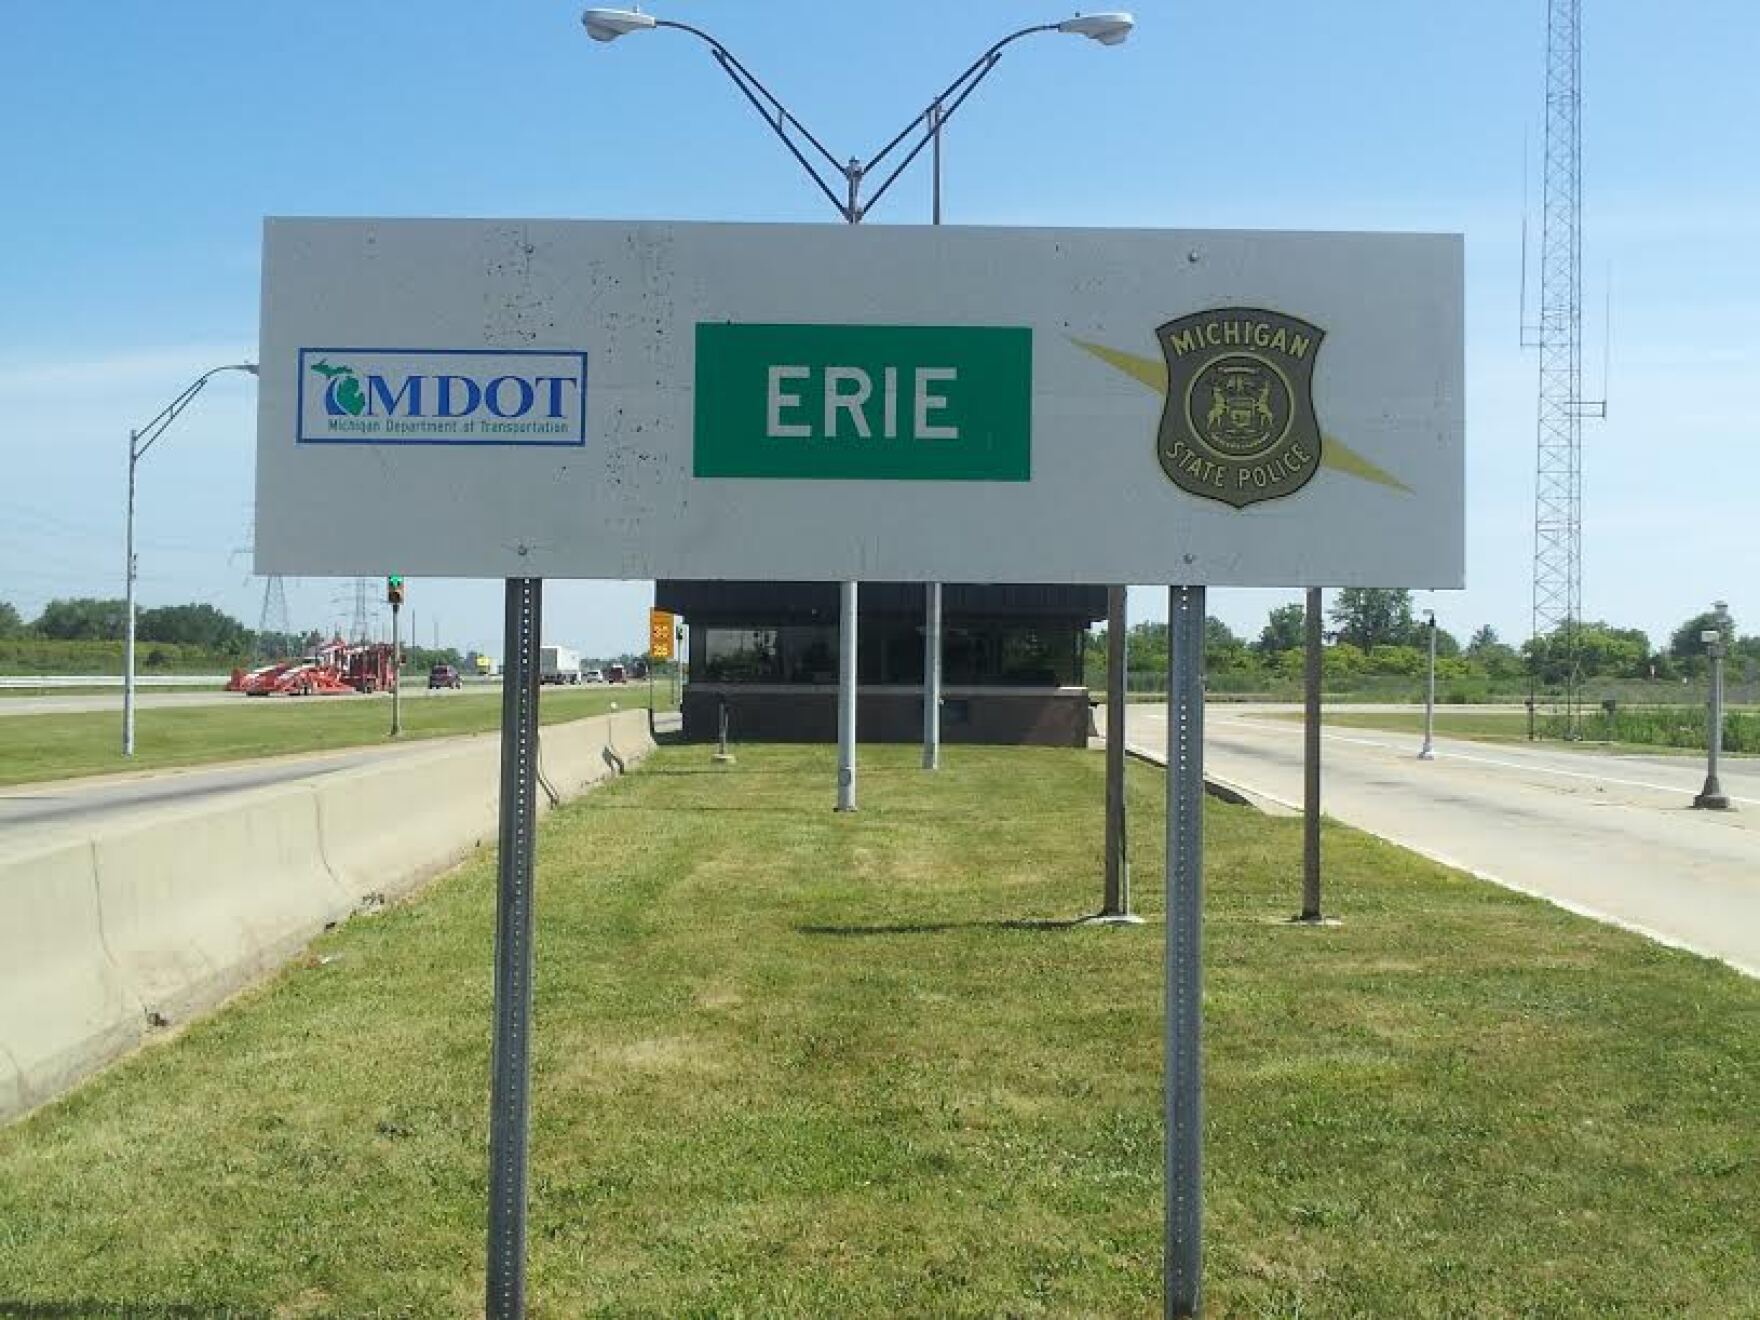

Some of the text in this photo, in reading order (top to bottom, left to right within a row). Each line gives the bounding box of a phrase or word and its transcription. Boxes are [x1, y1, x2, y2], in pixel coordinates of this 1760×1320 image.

[1170, 321, 1310, 358] MICHIGAN
[367, 374, 577, 418] MDOT
[766, 365, 959, 439] ERIE
[328, 418, 569, 435] Michigan Department of Transportation
[1166, 441, 1312, 488] STATE POLICE
